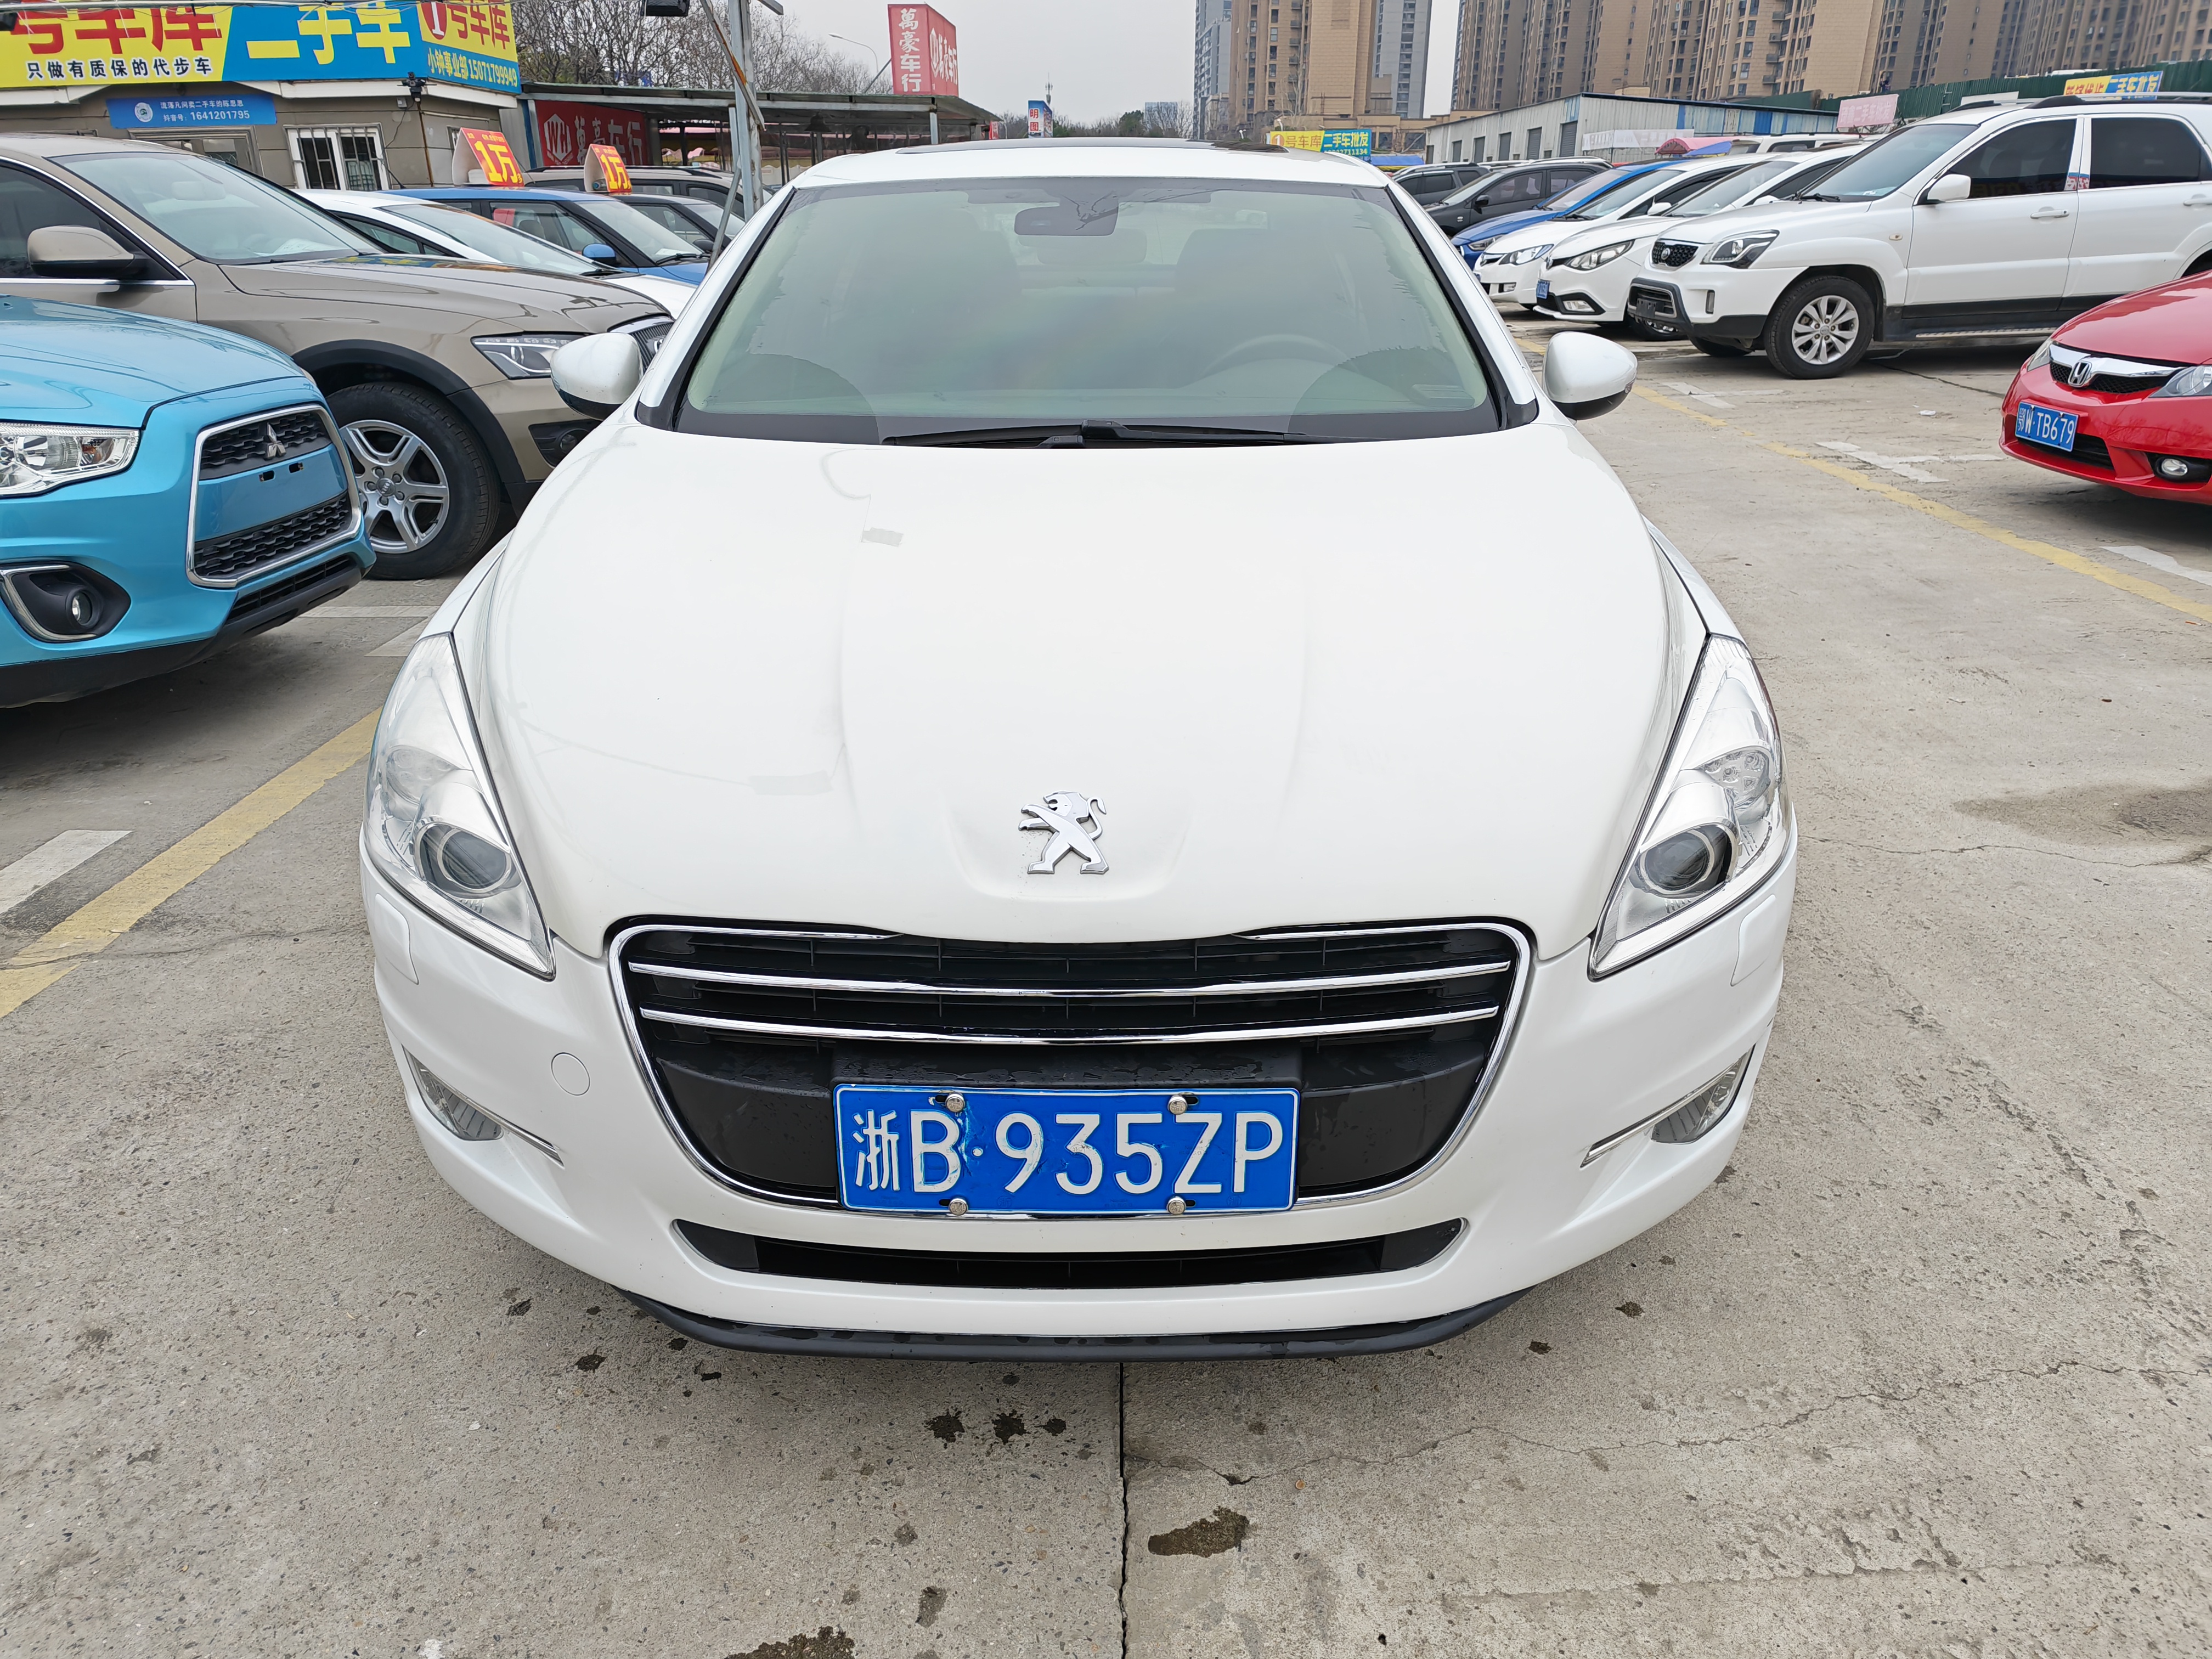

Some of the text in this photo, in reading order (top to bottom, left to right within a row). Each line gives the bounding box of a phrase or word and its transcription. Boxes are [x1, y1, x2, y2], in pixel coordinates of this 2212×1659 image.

[899, 8, 922, 92] 萬豪车行
[27, 57, 212, 79] 只做有质保的代步车
[190, 110, 250, 121] 1641201795
[1323, 132, 1369, 148] 二手车批发
[853, 1109, 1283, 1195] 浙B·935ZP
